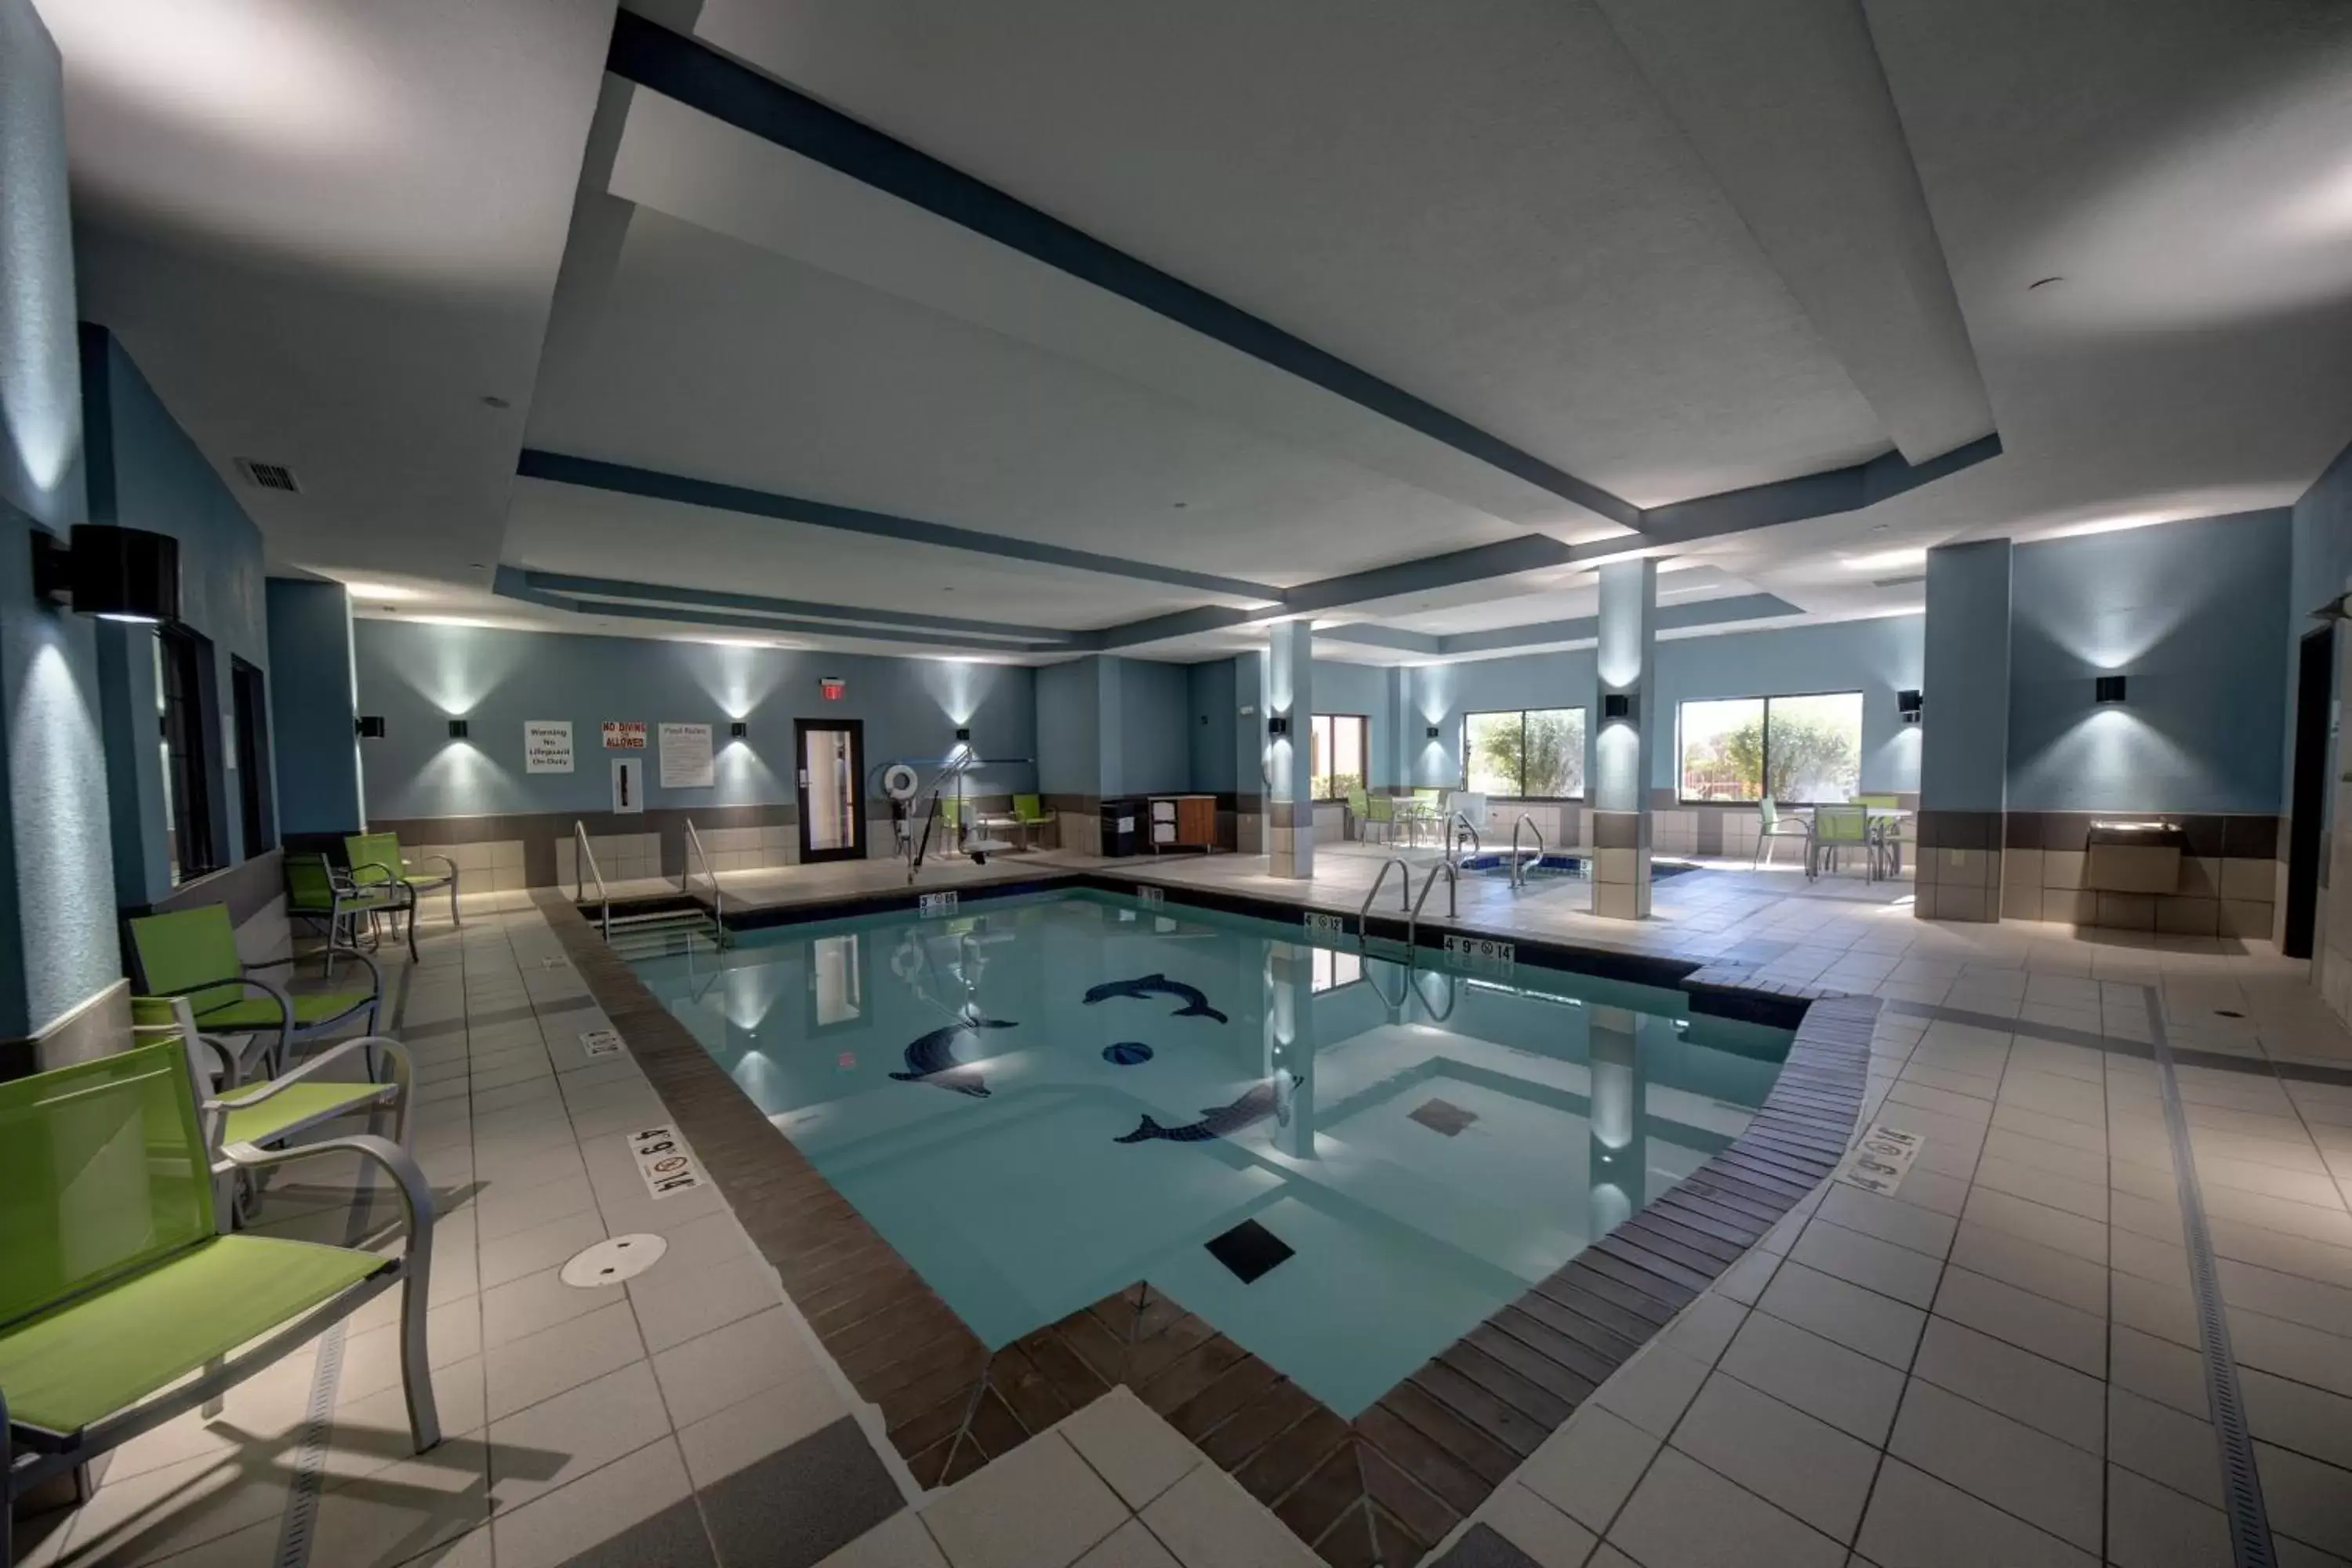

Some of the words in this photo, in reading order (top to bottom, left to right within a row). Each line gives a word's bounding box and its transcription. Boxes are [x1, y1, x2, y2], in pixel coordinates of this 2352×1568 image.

[603, 721, 615, 731] NO
[607, 737, 644, 747] ALLOWED
[1462, 940, 1471, 954] 9
[635, 1129, 669, 1141] 4
[640, 1141, 674, 1155] 9
